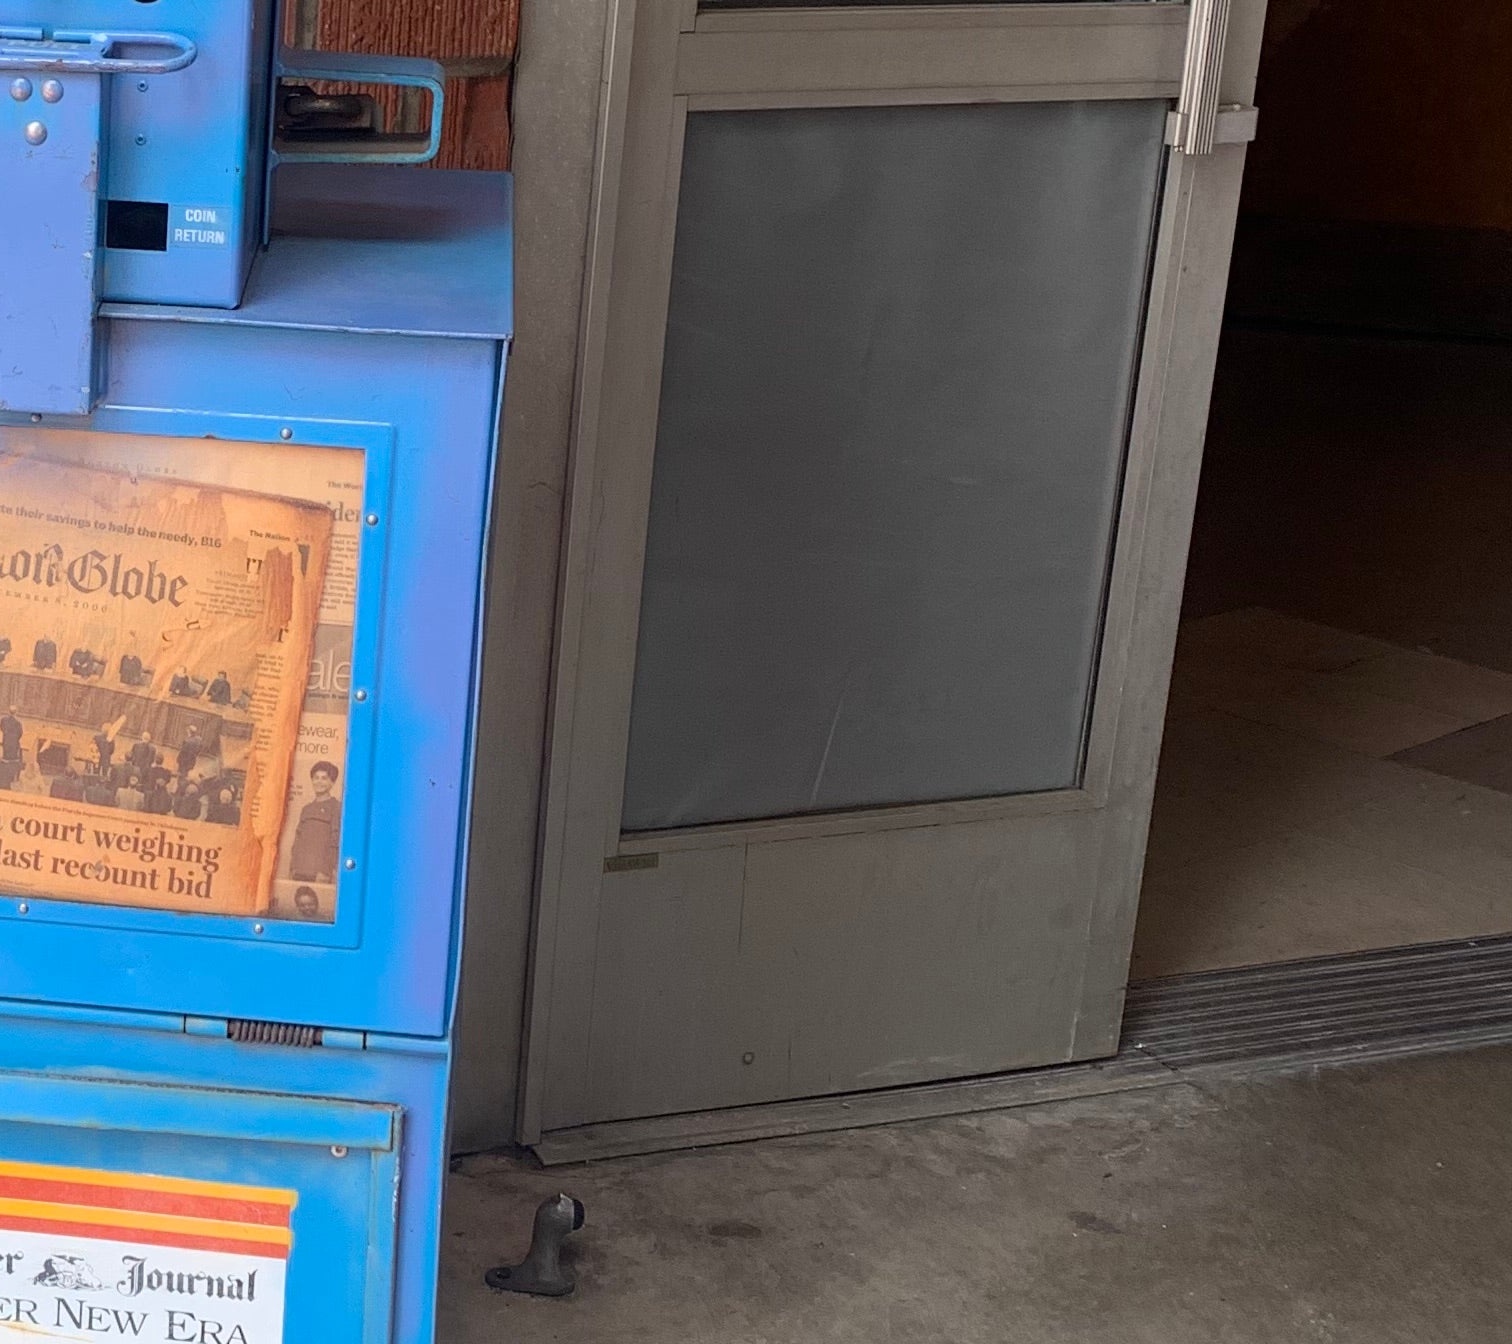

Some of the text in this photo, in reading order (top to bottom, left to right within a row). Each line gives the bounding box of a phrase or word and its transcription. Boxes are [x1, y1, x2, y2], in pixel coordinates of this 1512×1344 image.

[174, 228, 225, 244] RETURN
[185, 208, 216, 224] COIN
[16, 506, 44, 520] their
[46, 514, 92, 529] savings
[94, 519, 106, 530] to
[108, 521, 135, 536] help
[137, 526, 157, 538] the
[158, 531, 198, 546] needy,
[67, 549, 188, 607] Globe
[10, 816, 87, 845] court
[93, 827, 223, 873] weighing
[51, 858, 161, 890] recount
[168, 868, 215, 899] bid
[116, 1254, 259, 1303] Journal
[53, 1296, 150, 1337] NEW
